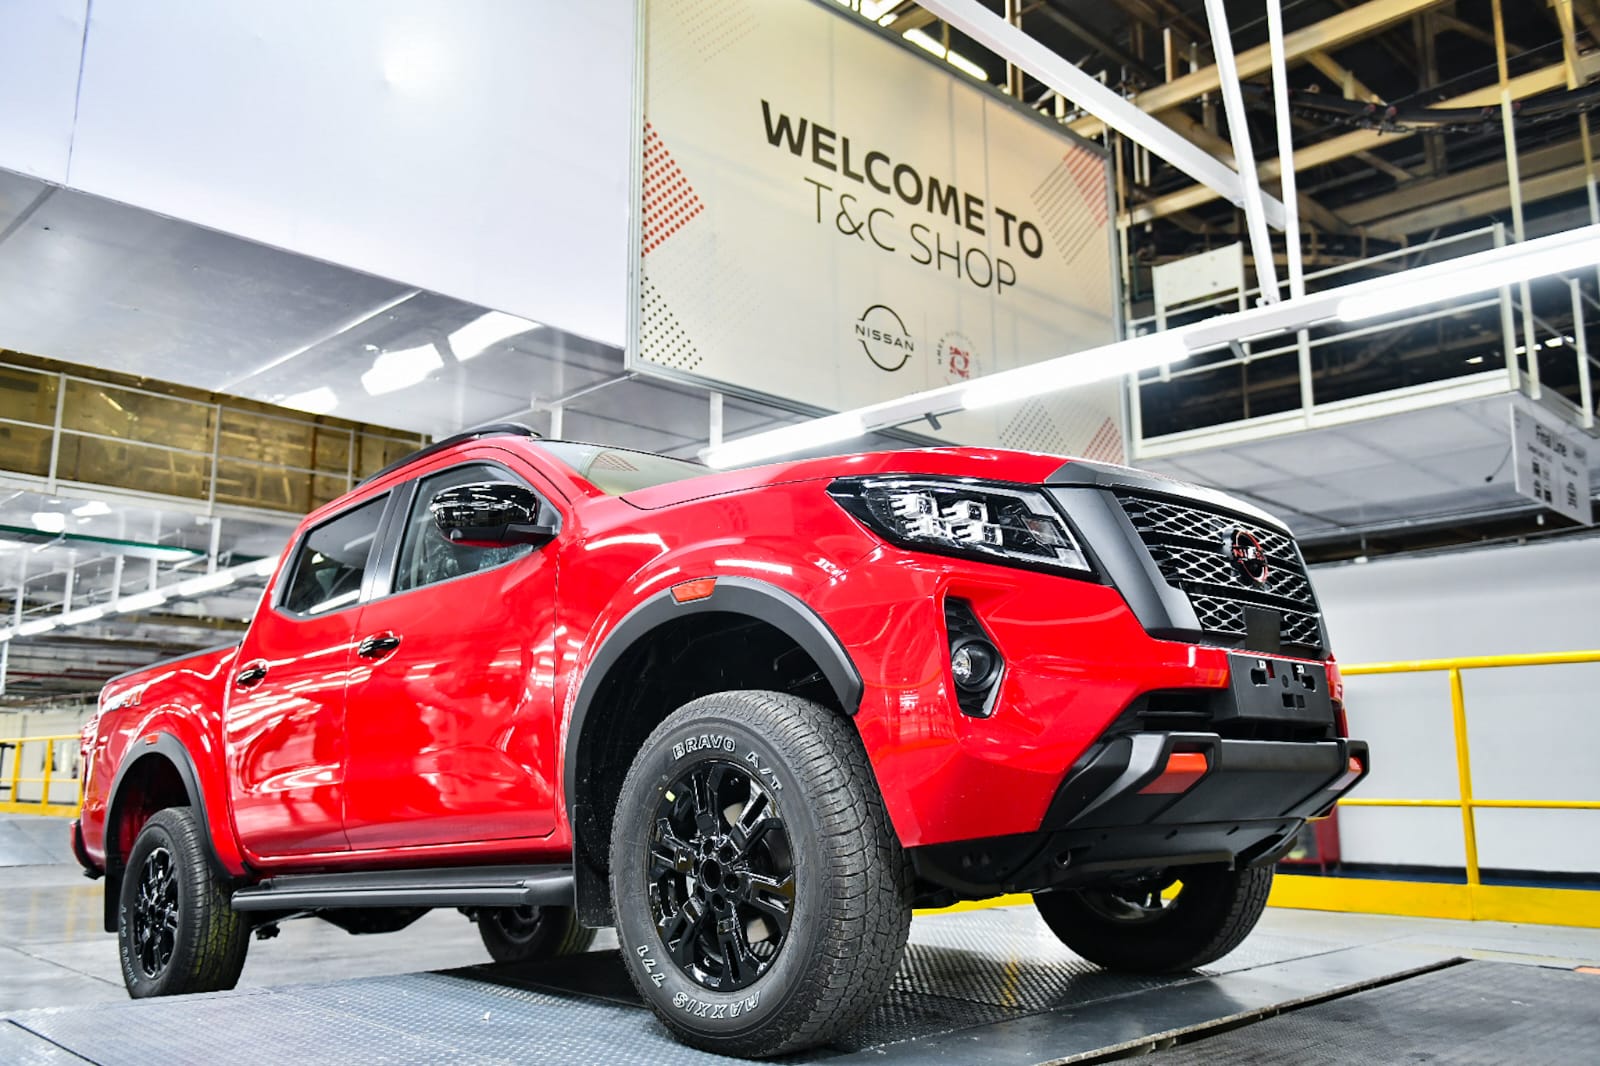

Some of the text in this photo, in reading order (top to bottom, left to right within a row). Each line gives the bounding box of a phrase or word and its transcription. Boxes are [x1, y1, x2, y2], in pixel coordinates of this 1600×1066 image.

[760, 98, 1043, 260] WELCOME TO
[803, 176, 1017, 295] T&C SHOP
[855, 323, 914, 352] NISSAN
[672, 734, 783, 790] BRAVO A/T
[636, 944, 760, 1019] MAXXIS 771
